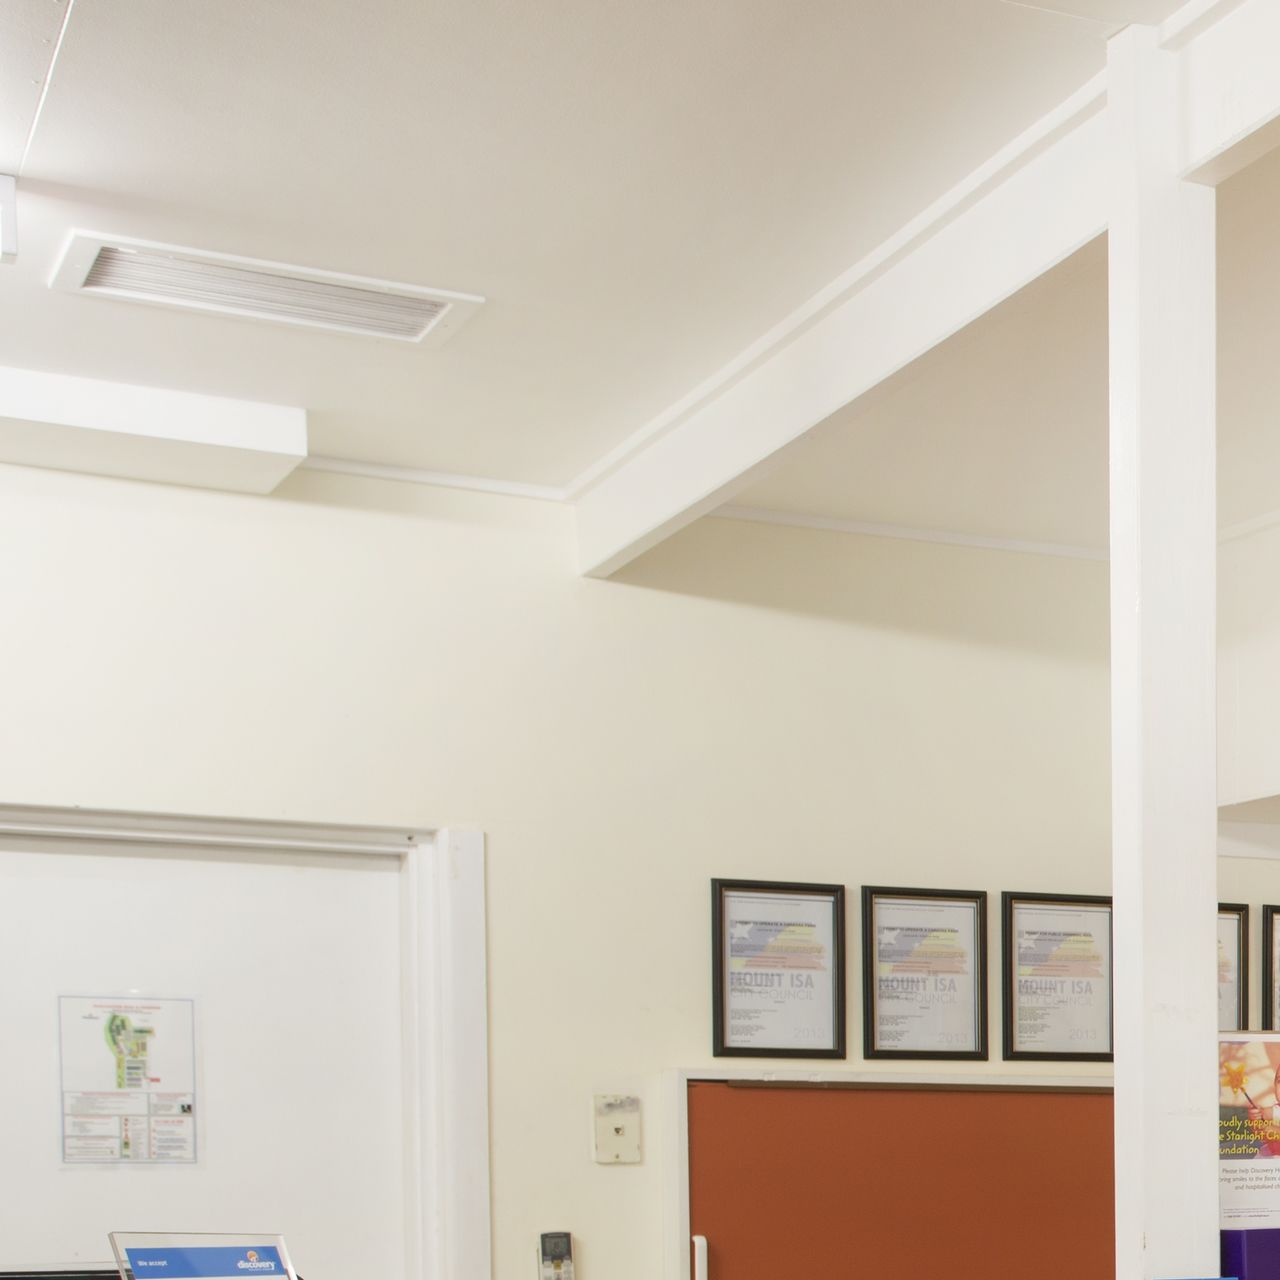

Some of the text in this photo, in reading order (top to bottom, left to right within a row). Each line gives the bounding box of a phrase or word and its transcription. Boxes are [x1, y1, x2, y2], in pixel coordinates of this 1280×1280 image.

[730, 972, 814, 989] MOUNT ISA
[878, 976, 958, 993] MOUNT ISA
[1018, 979, 1093, 995] MOUNT ISA
[793, 1027, 825, 1040] 2013
[938, 1032, 968, 1045] 2013
[1069, 1028, 1097, 1041] 2013
[1219, 1115, 1242, 1130] oudly
[1226, 1129, 1265, 1143] Starlight
[1219, 1144, 1260, 1155] undation
[1250, 1167, 1273, 1175] Discovery
[237, 1258, 276, 1270] discovery
